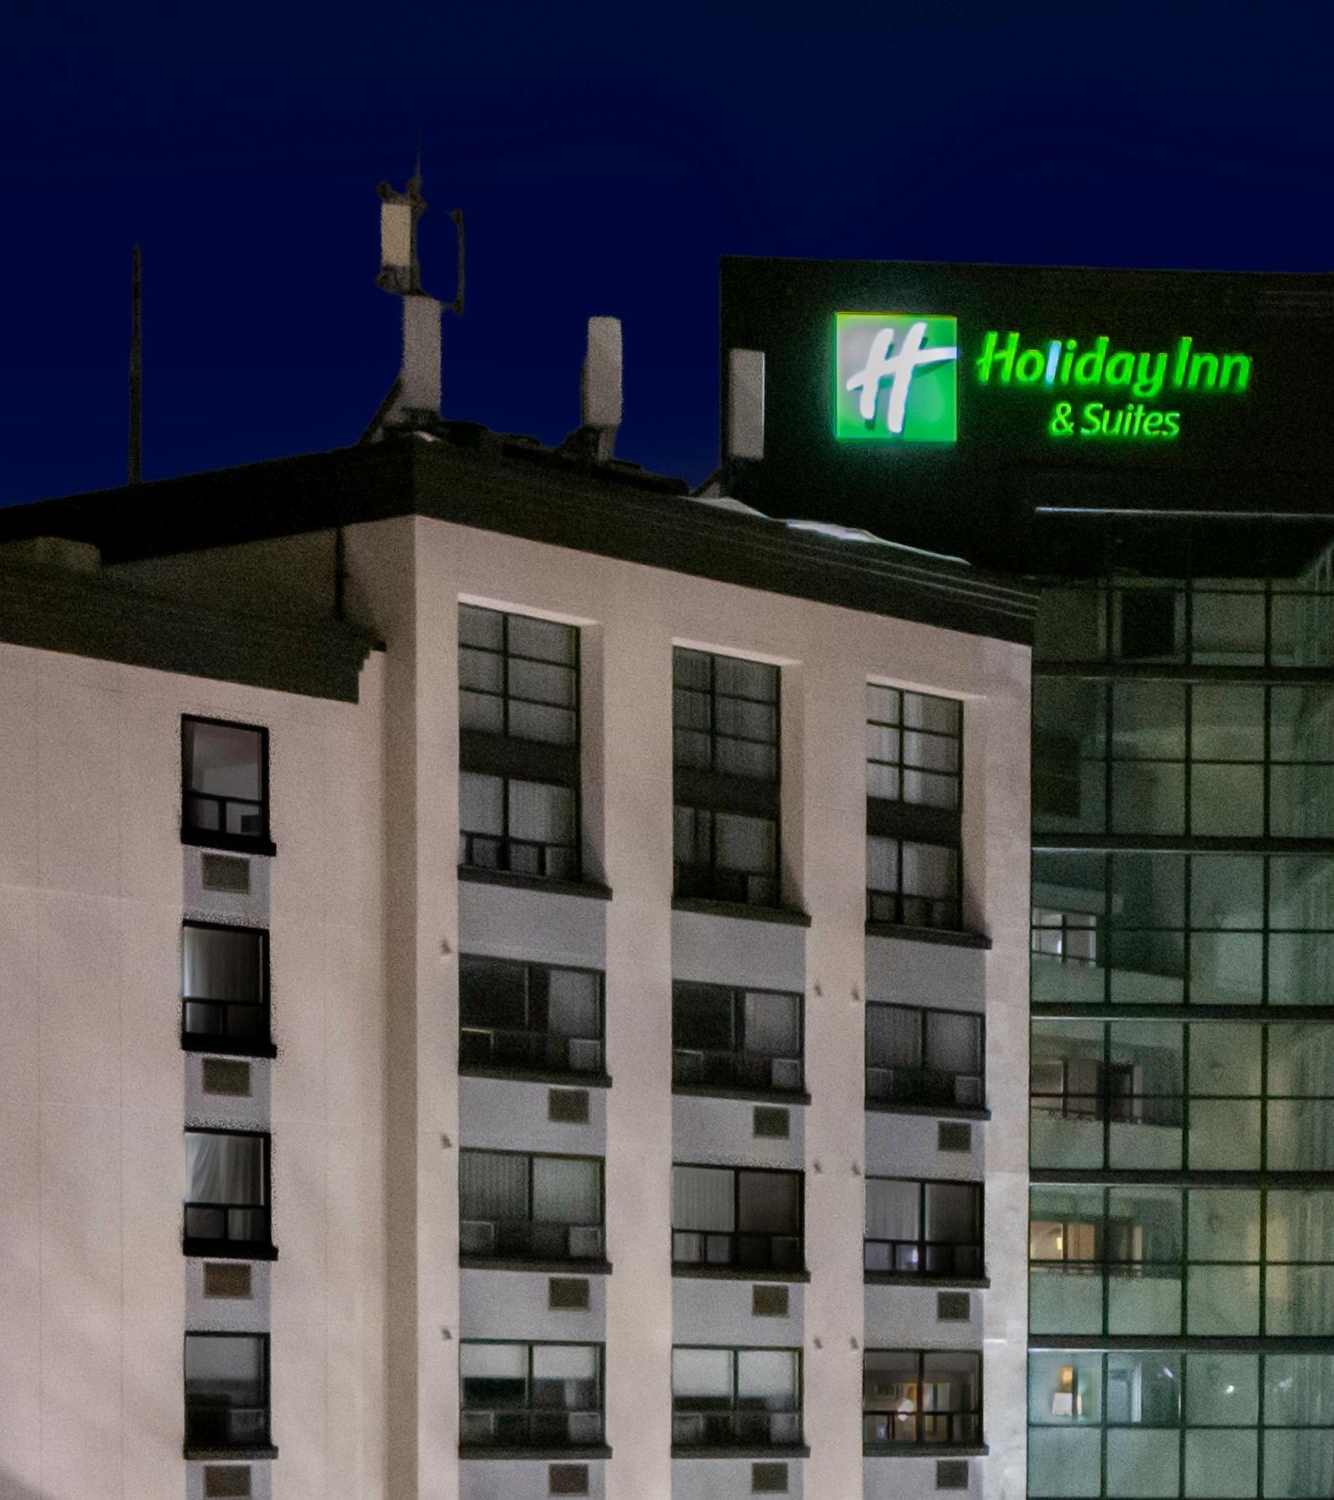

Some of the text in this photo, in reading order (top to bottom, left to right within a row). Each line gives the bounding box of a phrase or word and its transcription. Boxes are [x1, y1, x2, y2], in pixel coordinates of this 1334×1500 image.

[976, 331, 1252, 398] Holiday Inn
[1049, 401, 1181, 438] & Suites
